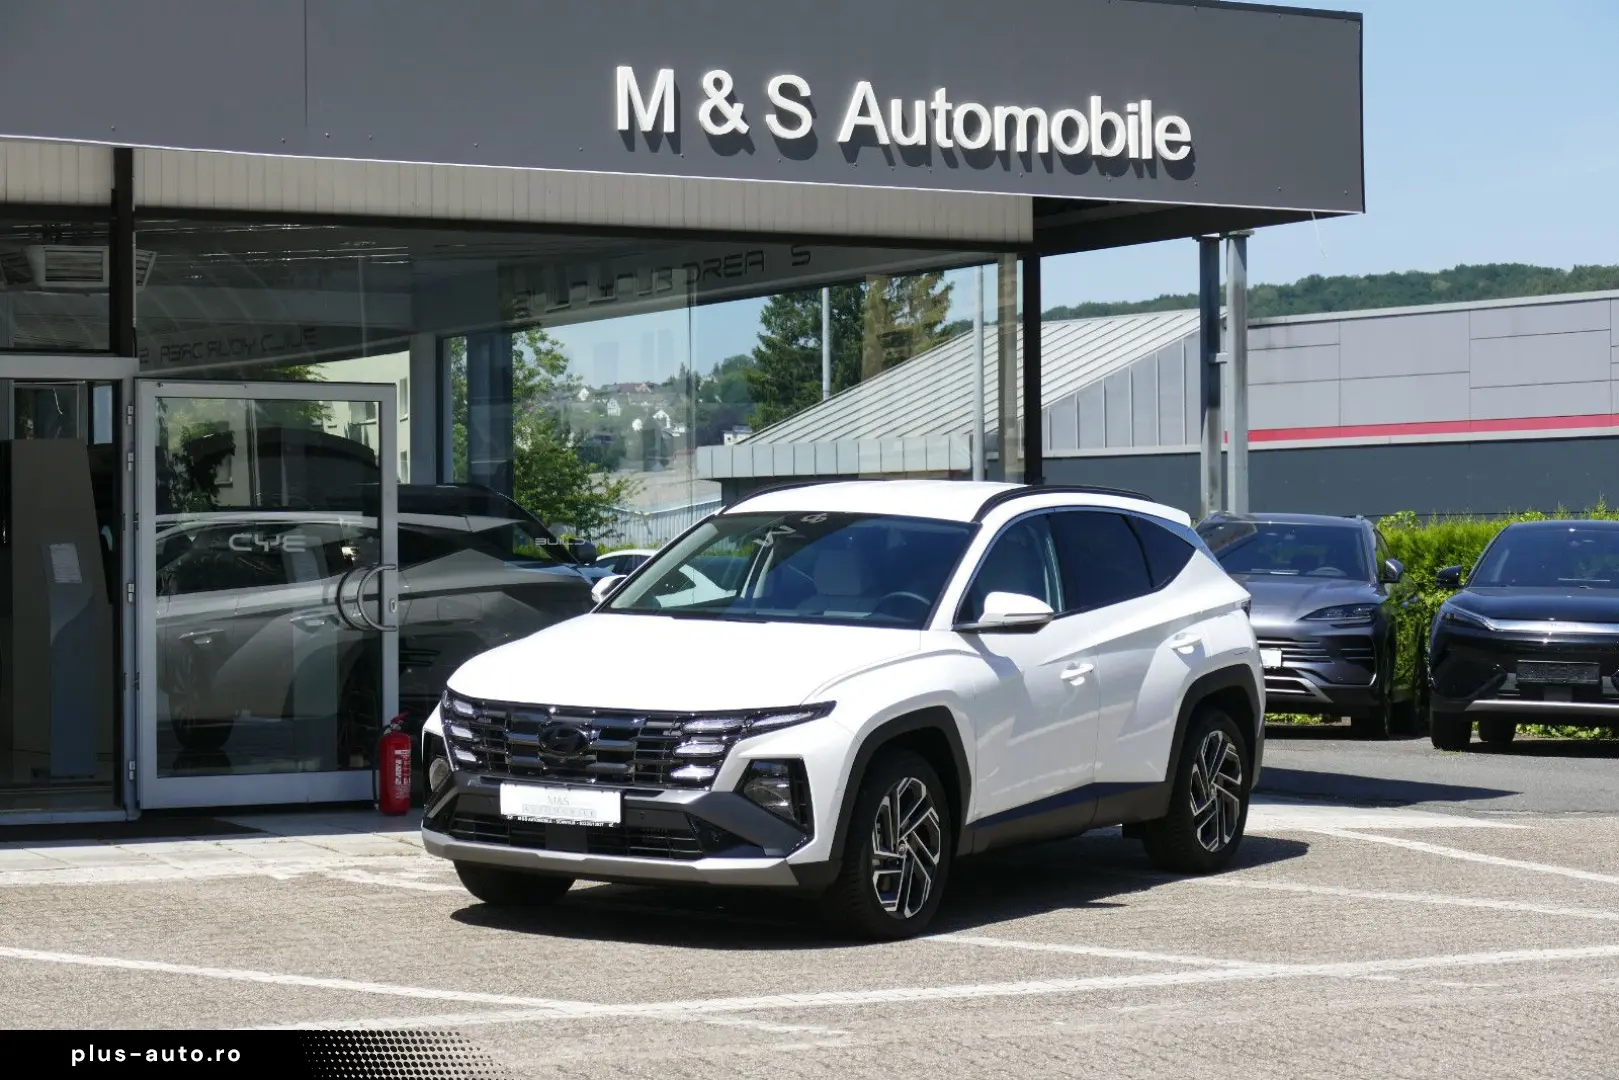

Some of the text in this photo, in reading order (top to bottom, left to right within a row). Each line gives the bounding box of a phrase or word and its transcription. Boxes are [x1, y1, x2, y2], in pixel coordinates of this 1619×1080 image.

[615, 65, 1192, 161] M & S Automobile
